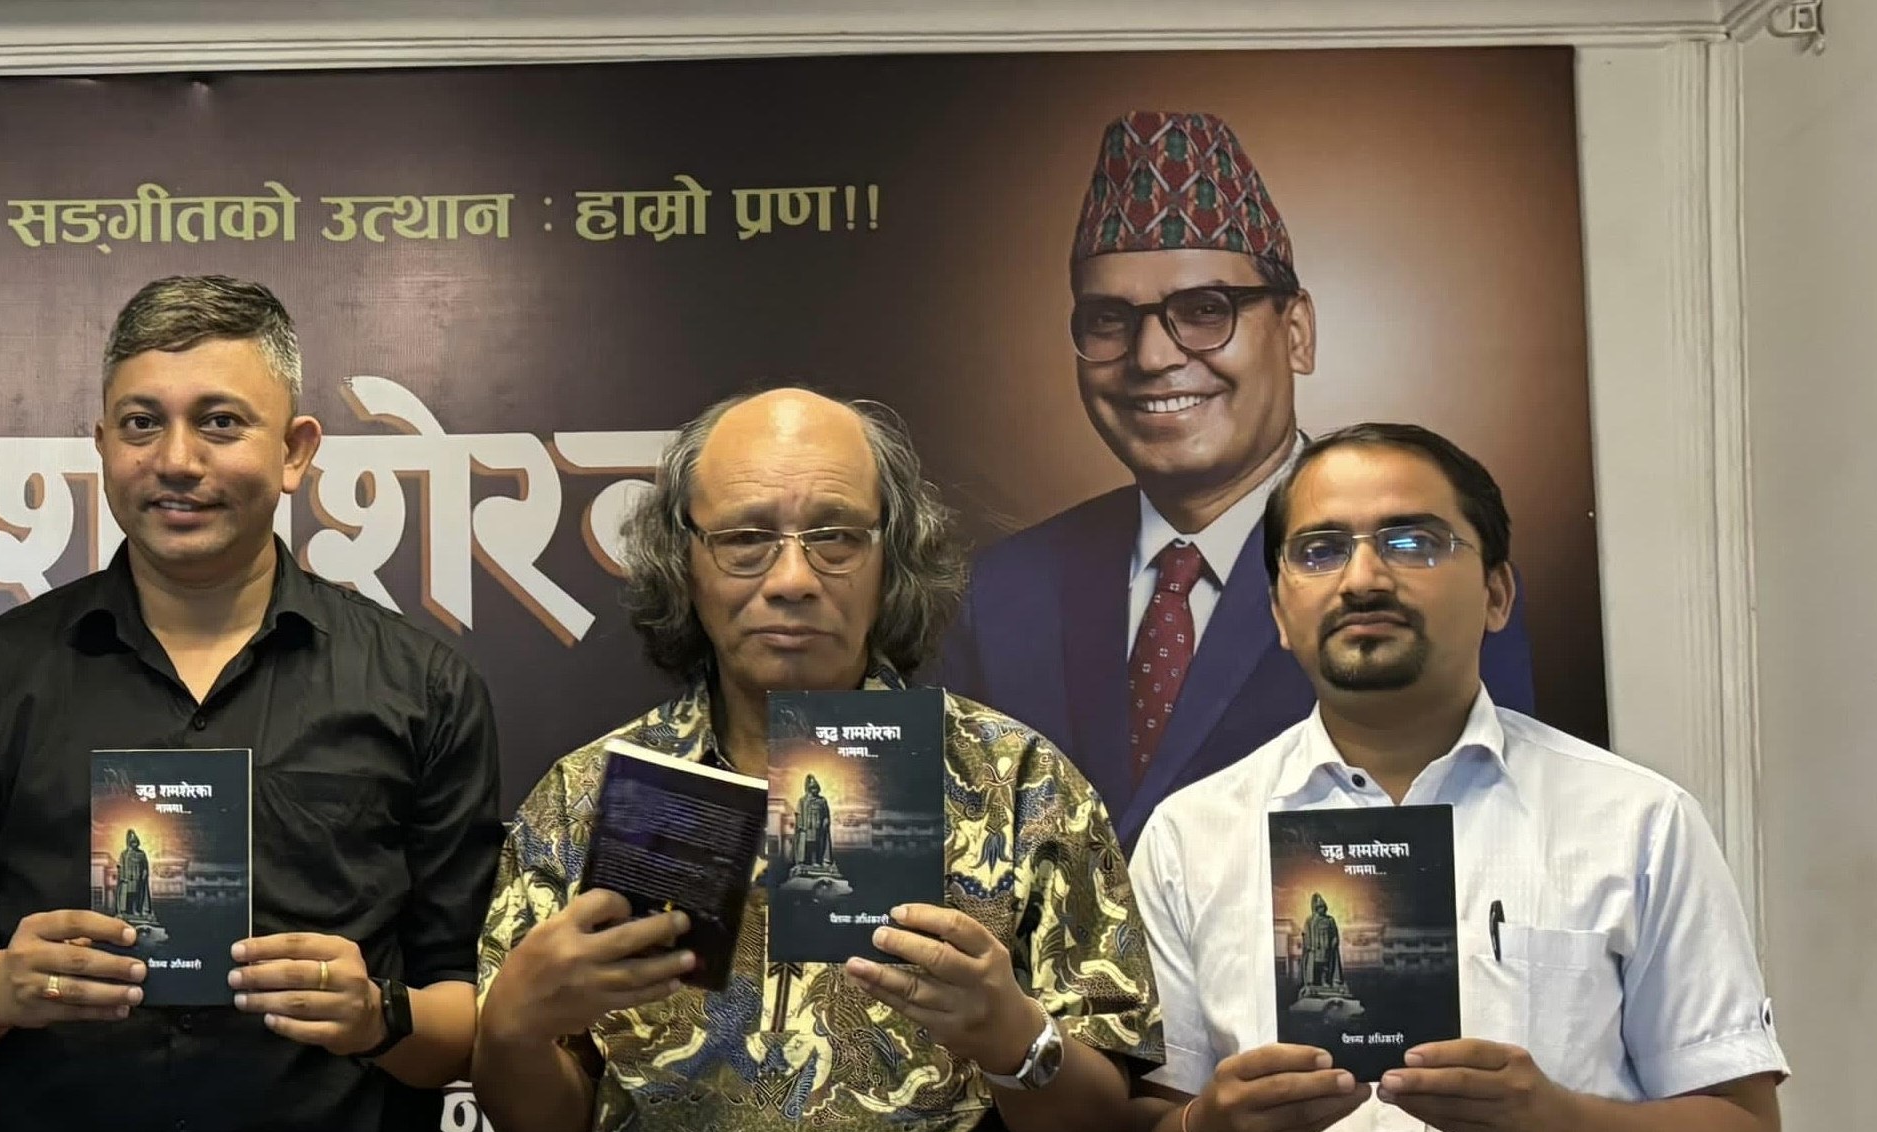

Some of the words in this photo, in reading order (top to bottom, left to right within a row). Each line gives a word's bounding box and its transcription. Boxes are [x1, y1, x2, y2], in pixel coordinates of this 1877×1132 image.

[320, 193, 516, 242] उत्थान
[574, 175, 712, 242] हाम्रो
[731, 184, 879, 241] प्रण!!
[1320, 844, 1345, 864] जुद्ध
[1347, 840, 1411, 858] शमशेरका
